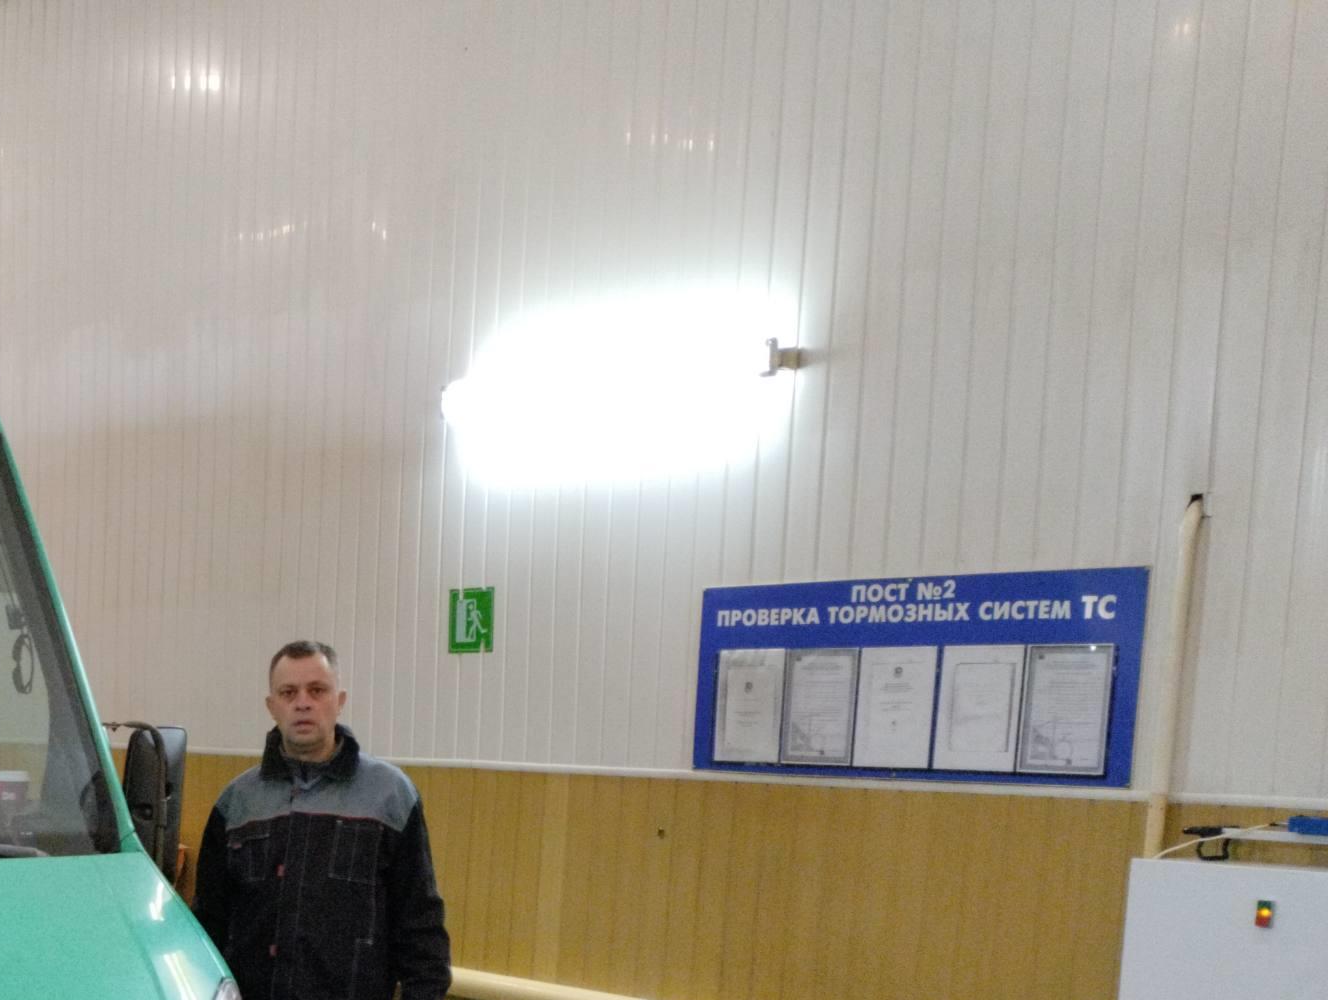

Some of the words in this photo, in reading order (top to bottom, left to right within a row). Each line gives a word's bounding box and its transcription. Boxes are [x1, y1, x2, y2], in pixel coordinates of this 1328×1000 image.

[851, 582, 910, 603] ПОСТ
[916, 578, 957, 601] №2
[716, 606, 821, 628] ПРОВЕРКА
[827, 601, 971, 625] ТОРМОЗНЫХ
[978, 599, 1072, 621] СИСТЕМ
[1081, 594, 1118, 620] ТС
